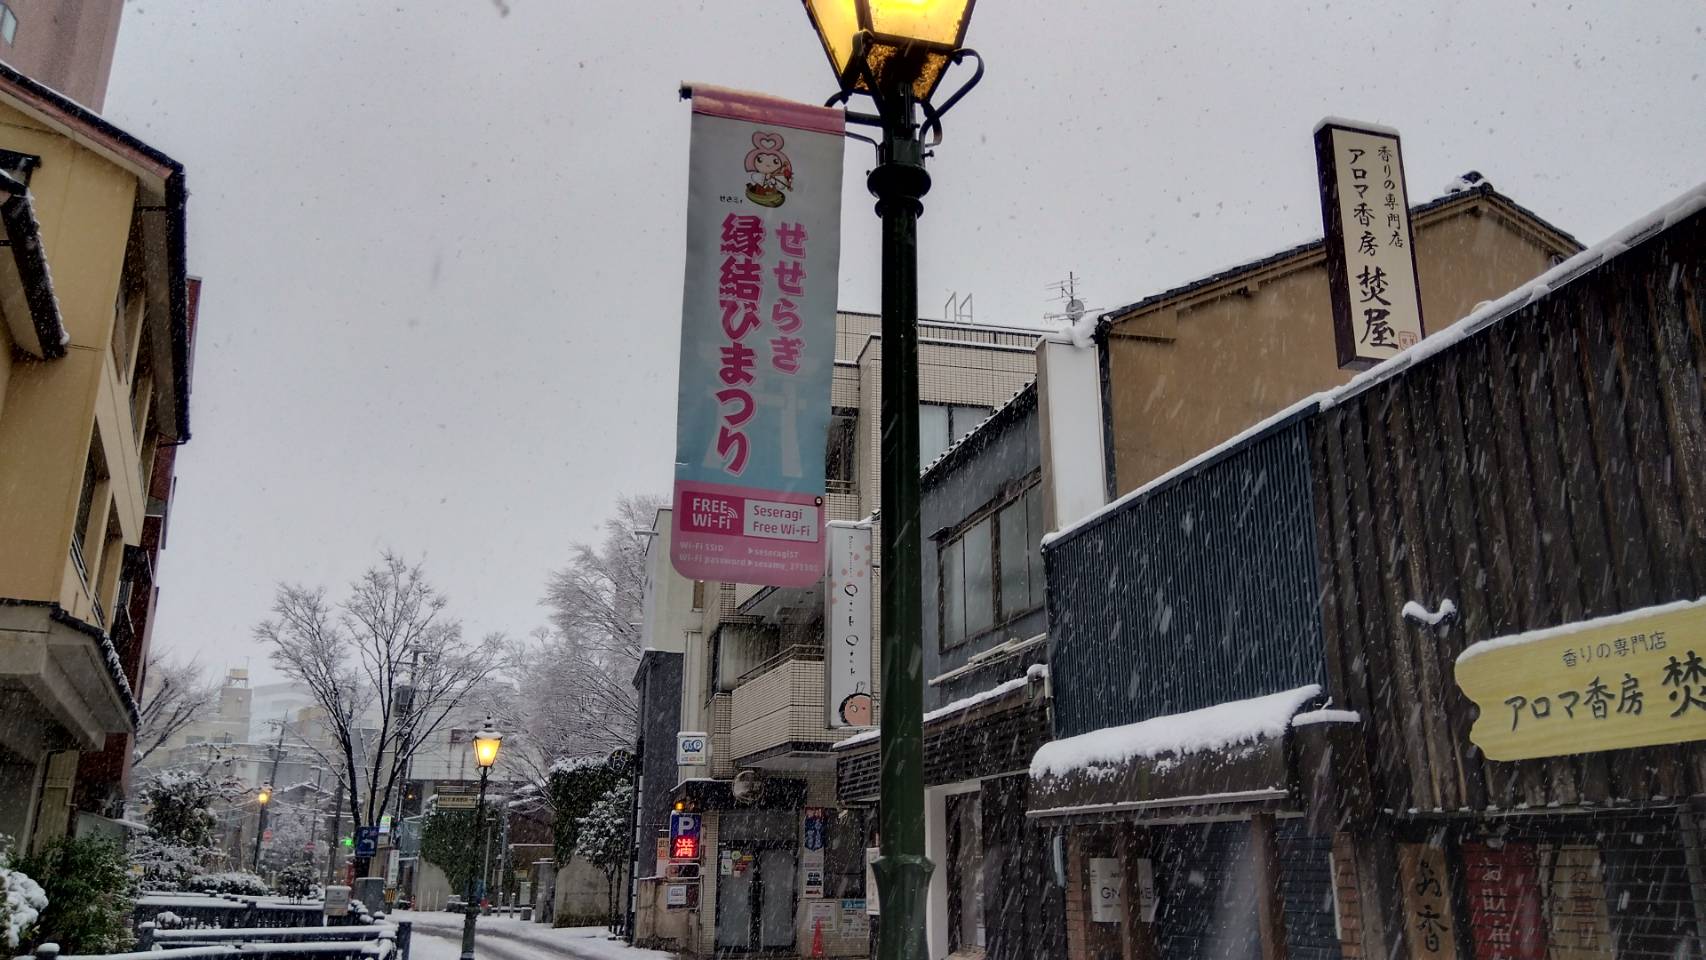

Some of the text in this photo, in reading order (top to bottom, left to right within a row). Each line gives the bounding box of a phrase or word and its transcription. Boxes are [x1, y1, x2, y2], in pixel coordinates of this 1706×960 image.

[1378, 146, 1404, 249] 香りの専門店
[1348, 148, 1400, 350] アロマ香房 焚屋
[771, 220, 809, 375] せせらぎ
[715, 213, 765, 476] 縁結びまつり
[692, 497, 728, 514] FREE
[753, 504, 803, 522] Seseragi
[692, 513, 731, 529] Wi-Fi
[753, 521, 810, 537] Free Wi-Fi
[1562, 631, 1667, 667] 香りの専門店
[1504, 672, 1645, 732] アロマ香房
[678, 817, 694, 835] P
[675, 838, 694, 857] 満
